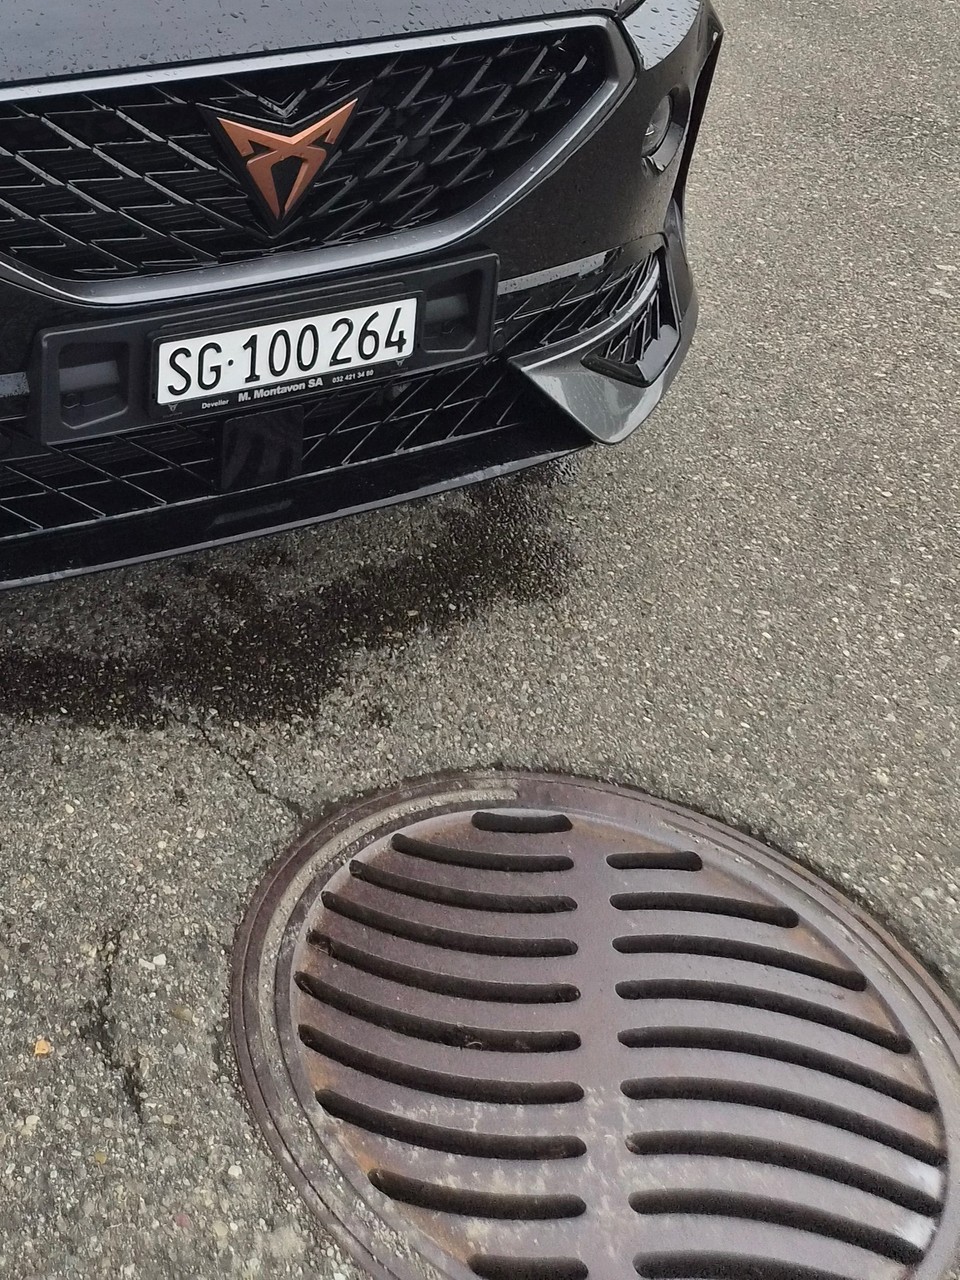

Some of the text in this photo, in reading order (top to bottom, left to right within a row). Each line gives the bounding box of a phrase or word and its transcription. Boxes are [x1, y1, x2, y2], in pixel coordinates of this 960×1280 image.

[238, 392, 252, 402] M.
[253, 383, 306, 399] Montavon
[307, 377, 323, 388] SA
